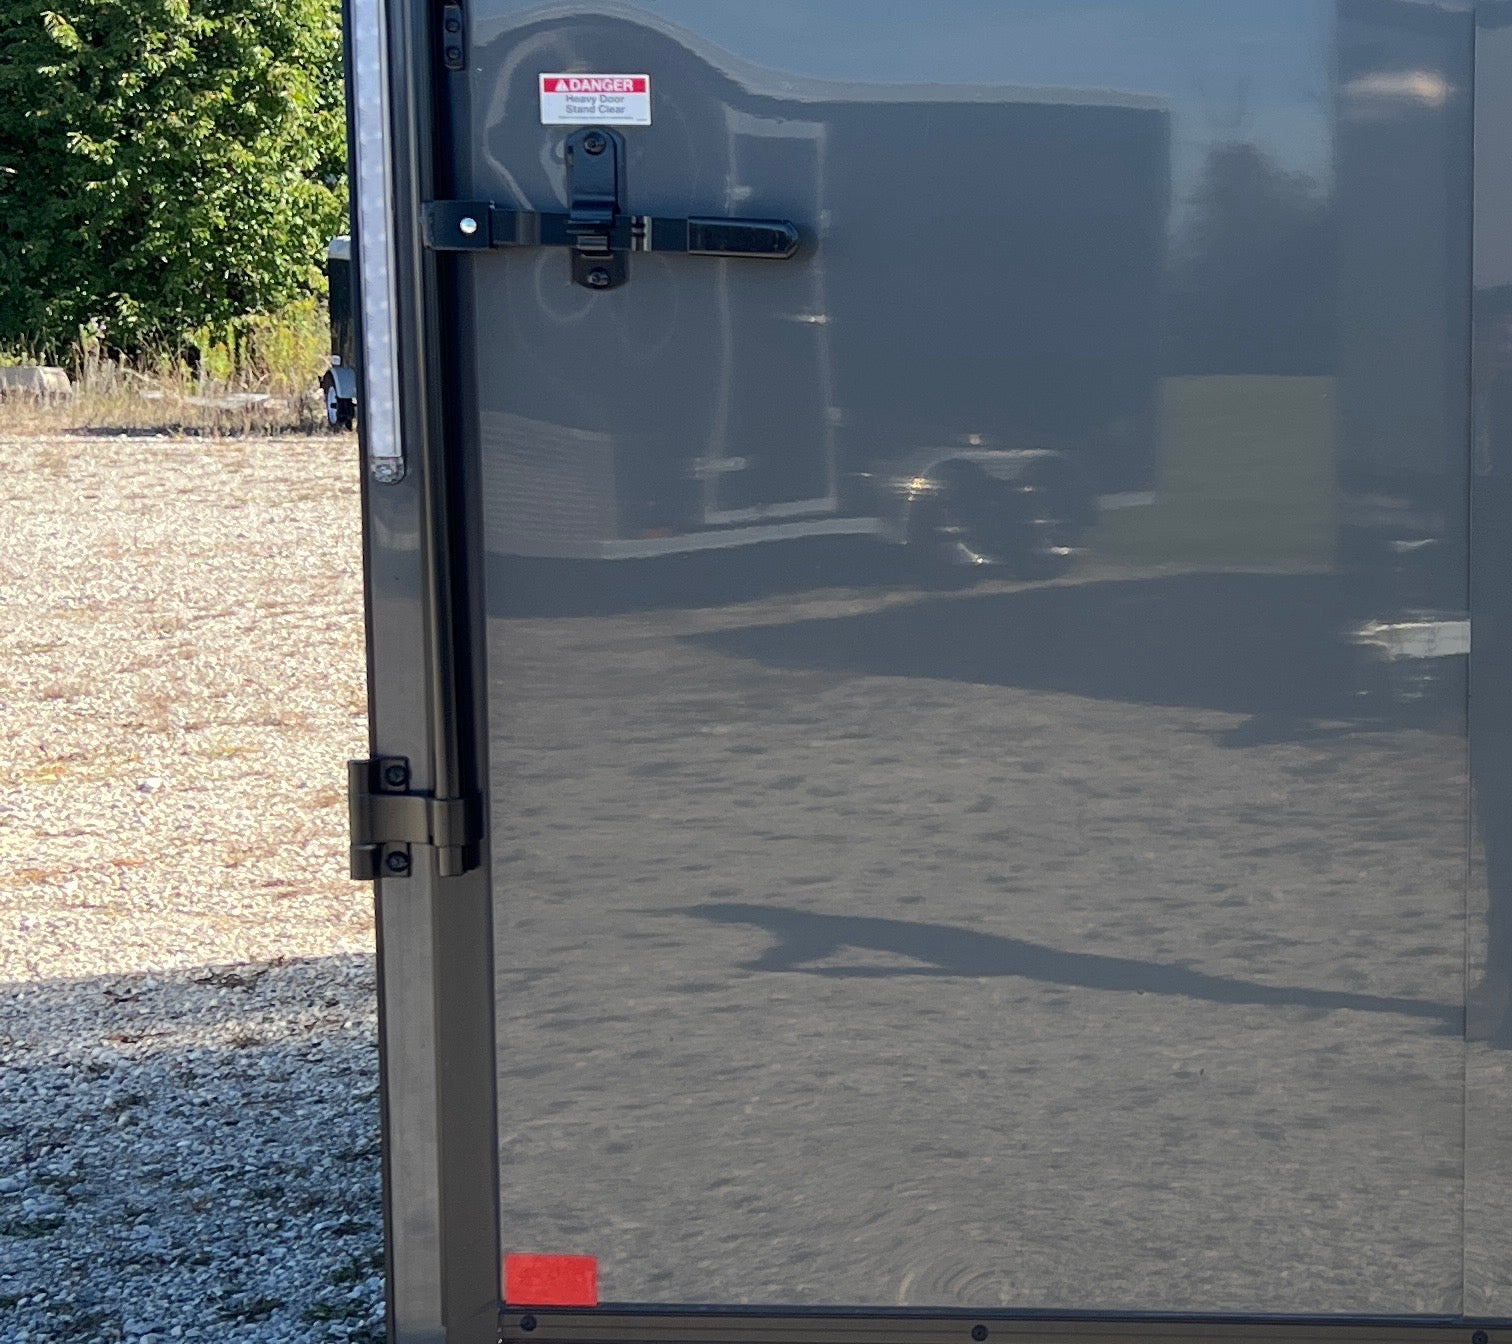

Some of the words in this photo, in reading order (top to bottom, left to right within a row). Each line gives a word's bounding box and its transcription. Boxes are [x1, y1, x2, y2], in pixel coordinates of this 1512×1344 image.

[569, 78, 634, 92] DANGER
[566, 94, 597, 105] Heavy
[600, 94, 625, 104] Door
[566, 105, 596, 114] Stand
[598, 105, 626, 114] Clear
